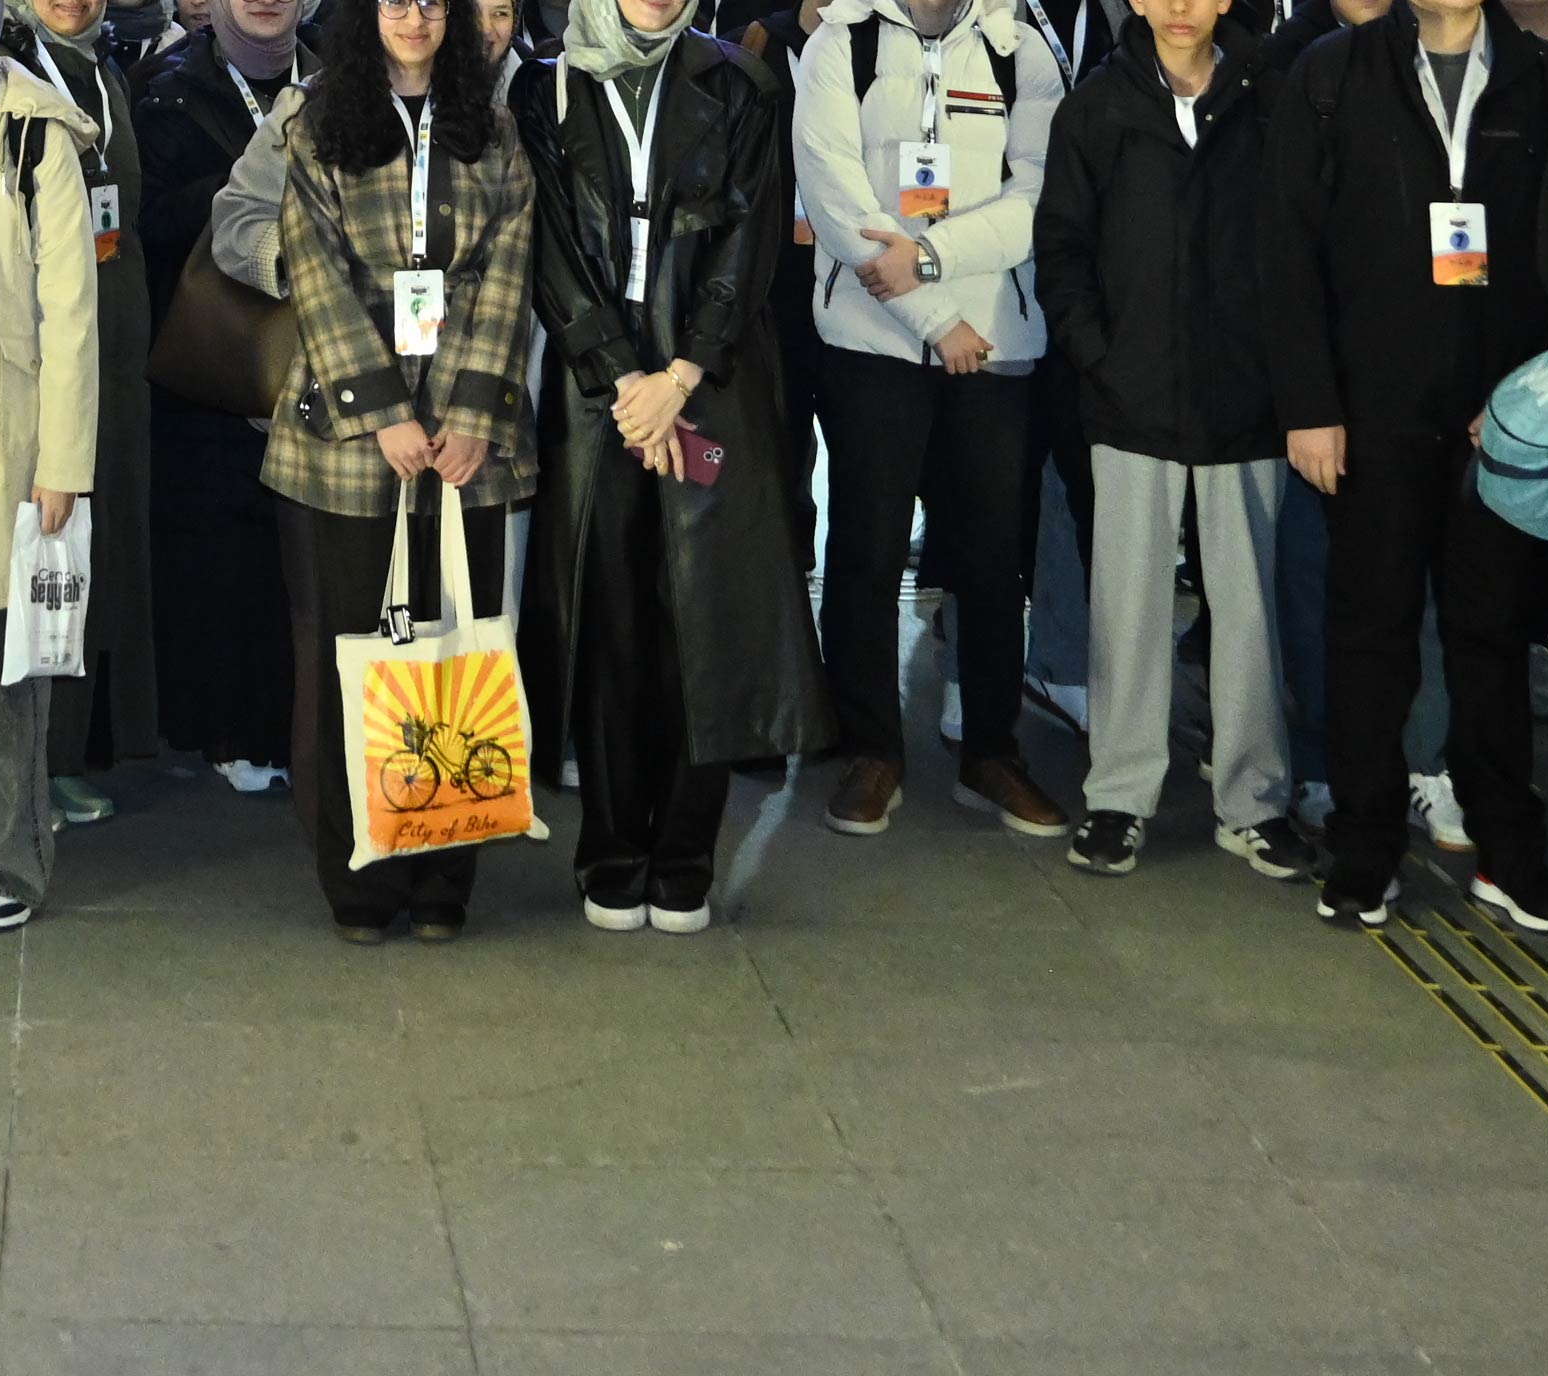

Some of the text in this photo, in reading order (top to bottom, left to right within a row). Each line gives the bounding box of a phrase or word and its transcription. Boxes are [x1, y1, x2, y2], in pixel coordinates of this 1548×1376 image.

[30, 574, 80, 610] Seyyah
[398, 813, 498, 844] City of Bike
